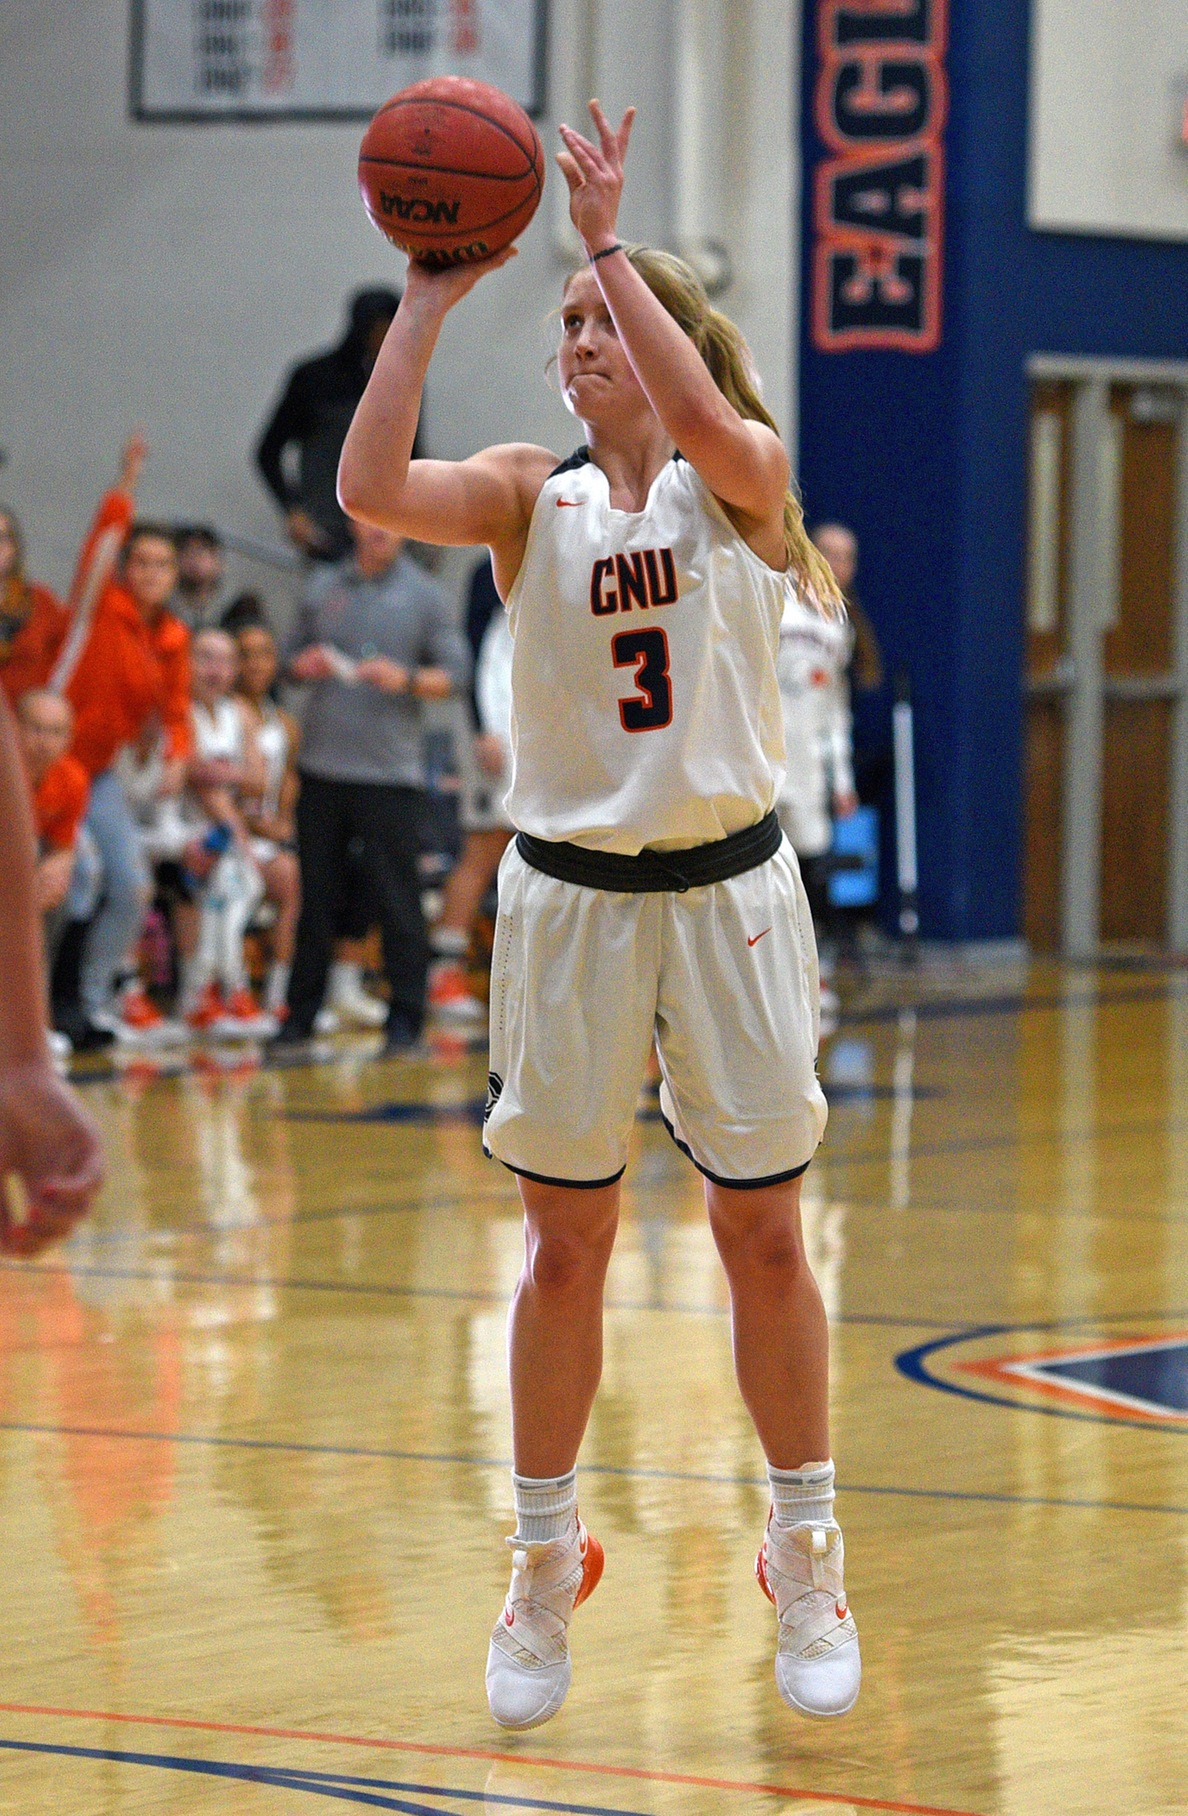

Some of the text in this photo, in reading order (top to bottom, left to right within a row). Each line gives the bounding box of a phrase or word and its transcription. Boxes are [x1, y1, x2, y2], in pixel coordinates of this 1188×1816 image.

[380, 191, 461, 225] NCAA
[590, 547, 679, 617] CNU
[611, 626, 673, 733] 3
